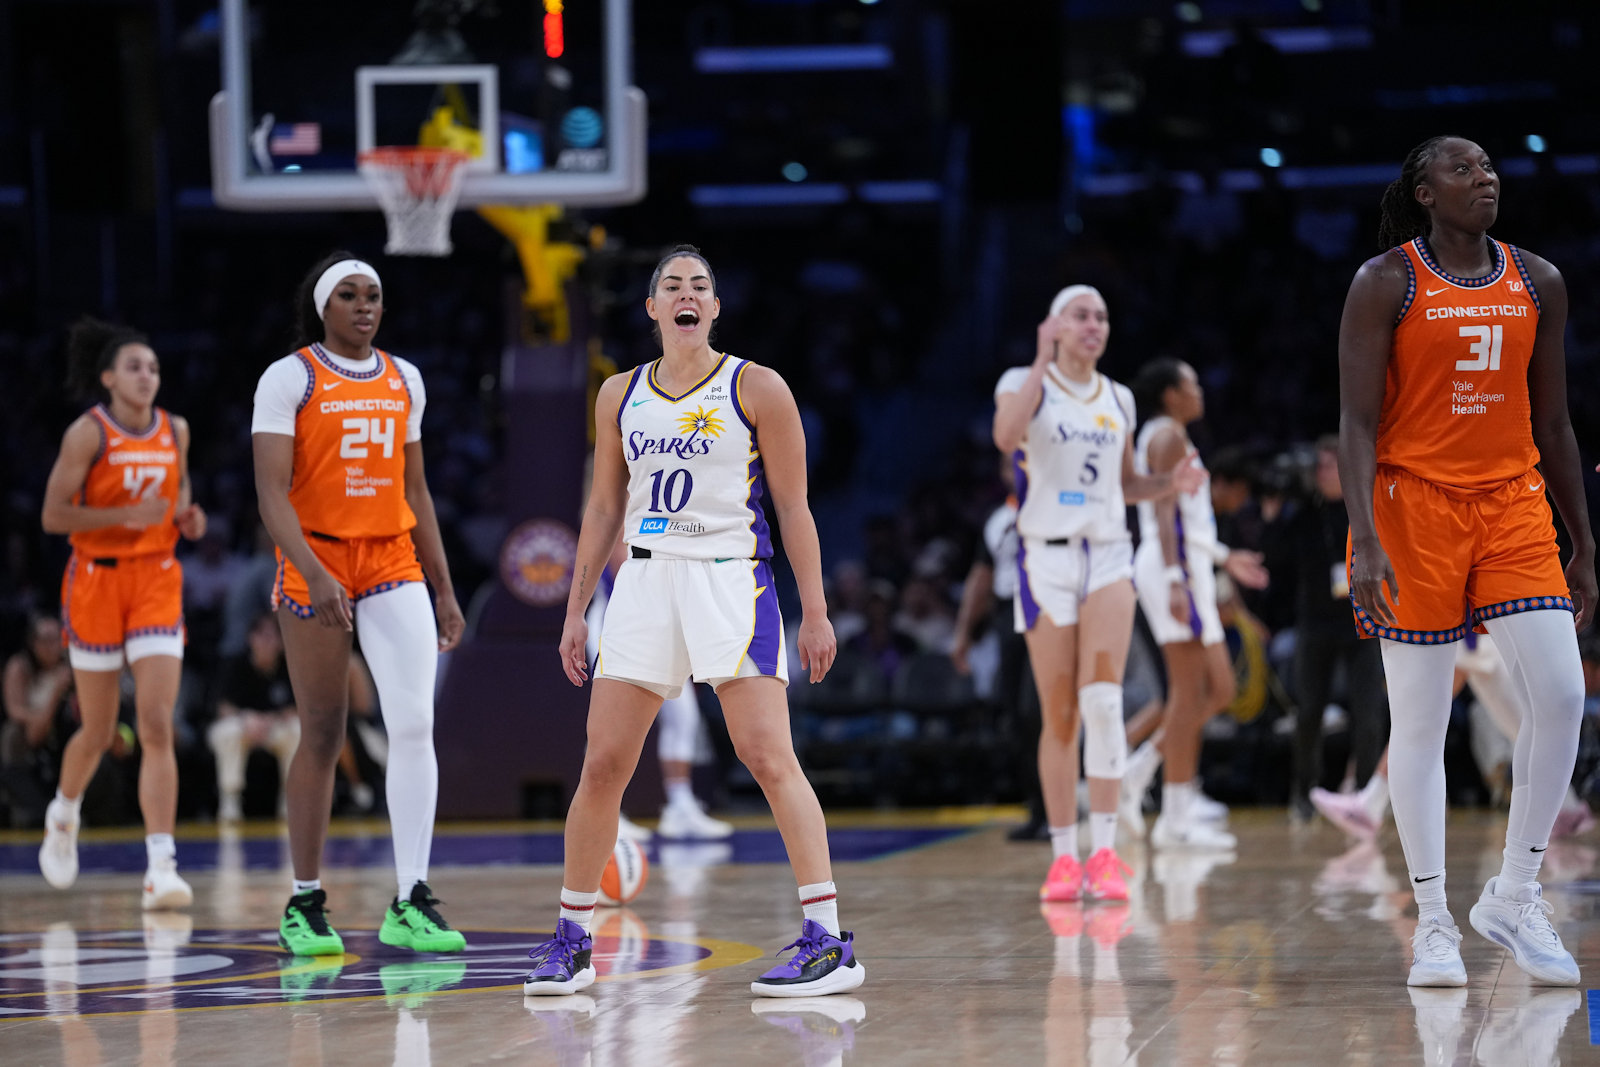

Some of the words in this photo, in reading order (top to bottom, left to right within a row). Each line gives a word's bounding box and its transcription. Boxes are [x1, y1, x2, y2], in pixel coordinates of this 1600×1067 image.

[1426, 305, 1528, 320] CONNECTICUT
[1455, 325, 1503, 372] 31
[1452, 381, 1474, 392] Yale
[704, 393, 728, 402] Albert
[1452, 392, 1505, 403] NewHaven
[320, 399, 405, 414] CONNECTICUT
[1451, 404, 1487, 415] Health
[339, 417, 396, 459] 24
[345, 466, 364, 477] Yale
[1079, 452, 1100, 487] 5
[122, 465, 167, 500] 47
[345, 486, 376, 497] Health
[648, 468, 693, 514] 10
[642, 521, 665, 531] UCLA
[668, 521, 705, 534] Health
